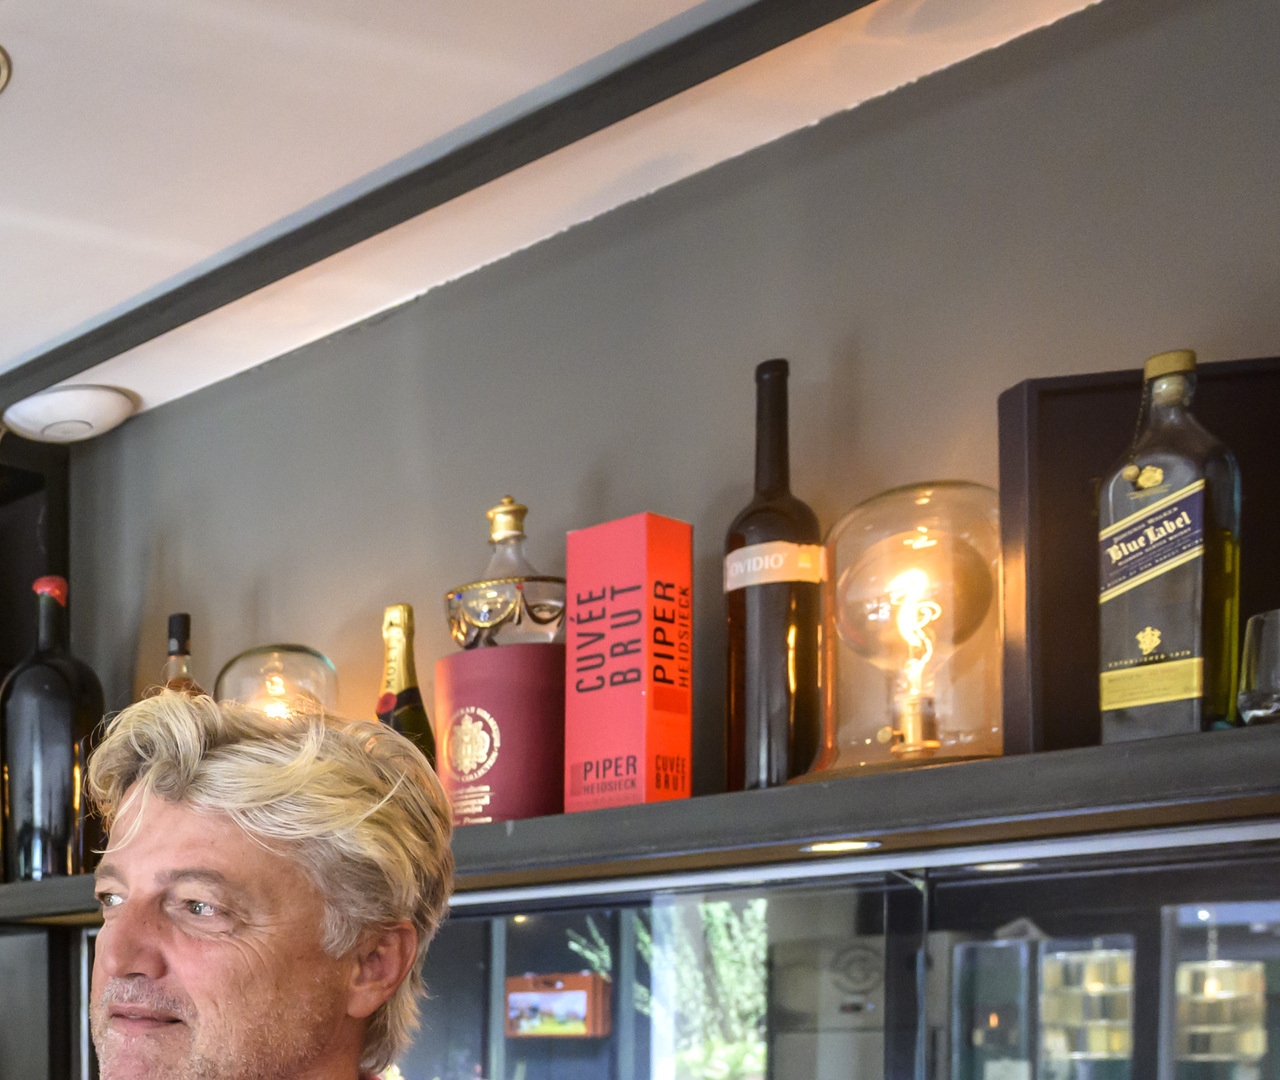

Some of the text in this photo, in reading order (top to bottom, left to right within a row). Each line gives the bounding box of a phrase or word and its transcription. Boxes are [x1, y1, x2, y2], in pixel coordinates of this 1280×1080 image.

[1105, 535, 1146, 565] Blue
[1142, 510, 1192, 545] Label
[570, 586, 606, 694] CUVÉE
[609, 583, 642, 687] BRUT
[652, 579, 676, 685] PIPER
[678, 585, 689, 688] HEIDSIECK
[583, 755, 637, 781] PIPER
[583, 778, 637, 794] HEIDSIECK
[655, 772, 686, 792] BRUT
